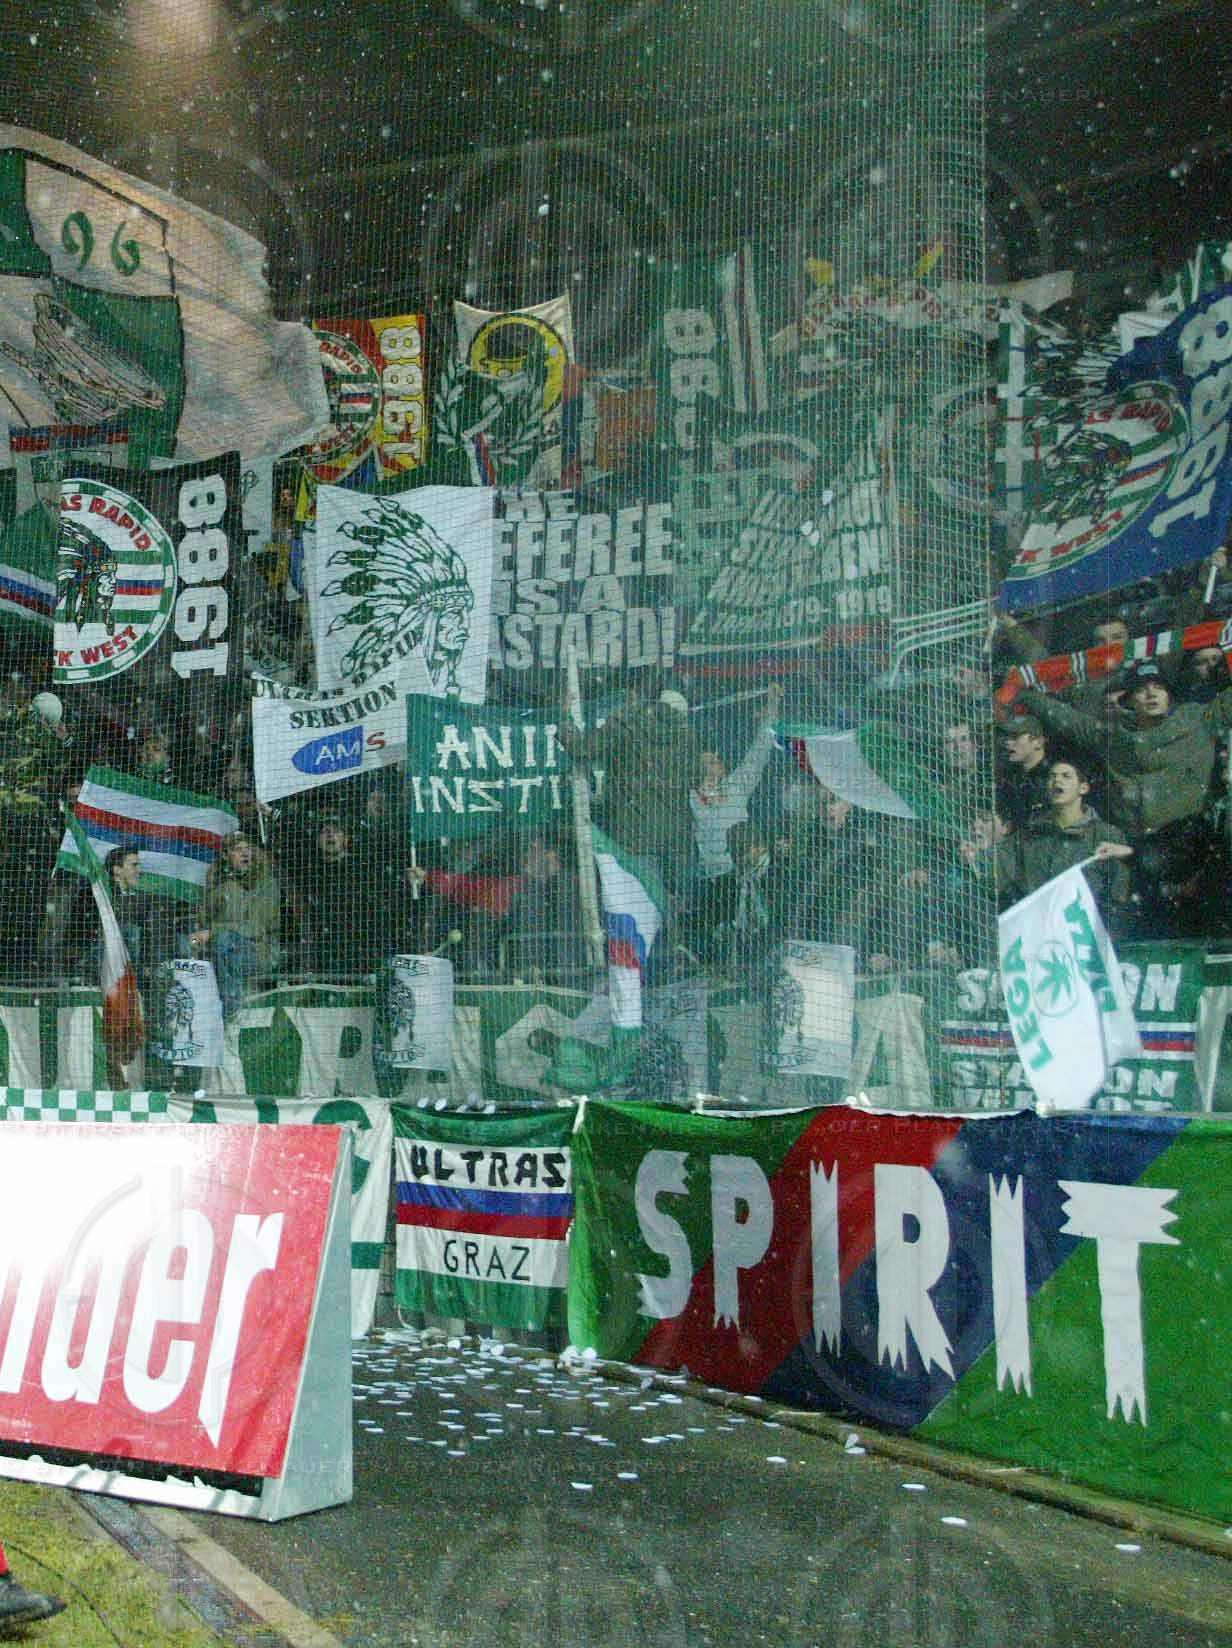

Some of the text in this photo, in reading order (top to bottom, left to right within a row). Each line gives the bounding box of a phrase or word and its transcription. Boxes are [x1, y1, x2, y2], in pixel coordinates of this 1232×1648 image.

[60, 210, 141, 277] 96
[88, 496, 152, 551] RAPID
[492, 503, 674, 583] EFEREE
[577, 574, 626, 614] A
[79, 624, 138, 665] WEST
[289, 680, 398, 730] SEKTION
[313, 730, 387, 766] AMS
[1002, 936, 1054, 1072] LEGA
[409, 1144, 567, 1189] ULTRAS
[442, 1239, 534, 1282] GRAZ
[634, 1149, 1181, 1428] SPIRIT
